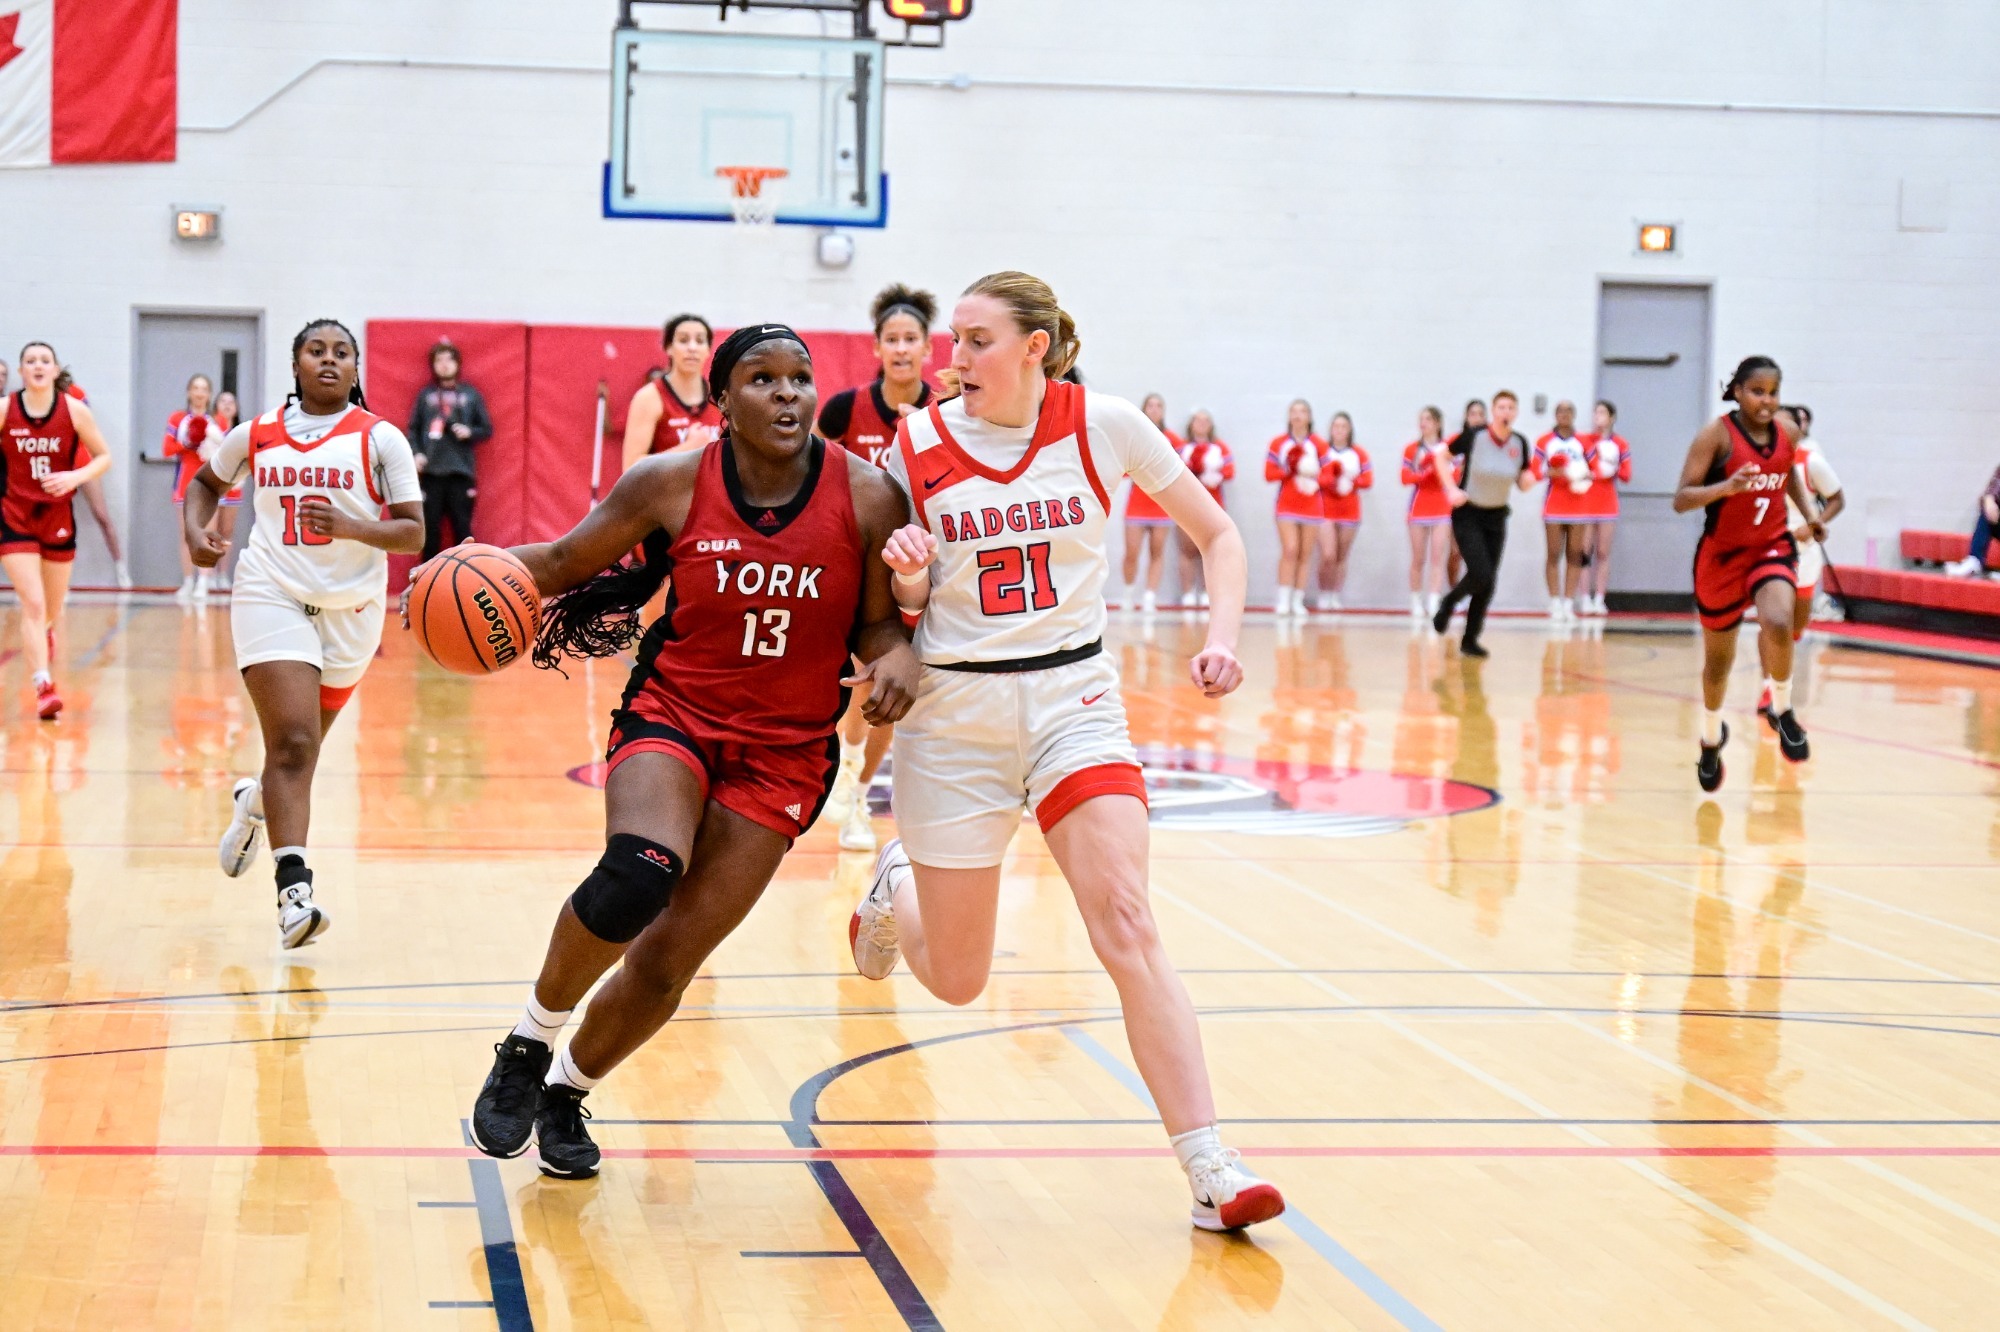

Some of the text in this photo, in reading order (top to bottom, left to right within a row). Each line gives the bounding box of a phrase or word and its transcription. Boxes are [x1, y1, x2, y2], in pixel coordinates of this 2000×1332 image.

[15, 437, 61, 454] YORK
[258, 466, 355, 490] BADGERS
[940, 495, 1086, 543] BADGERS
[1753, 497, 1770, 526] 7
[695, 538, 742, 552] OUA
[714, 557, 822, 600] YORK
[976, 541, 1059, 616] 21
[473, 585, 518, 669] Wilson
[740, 604, 791, 658] 13
